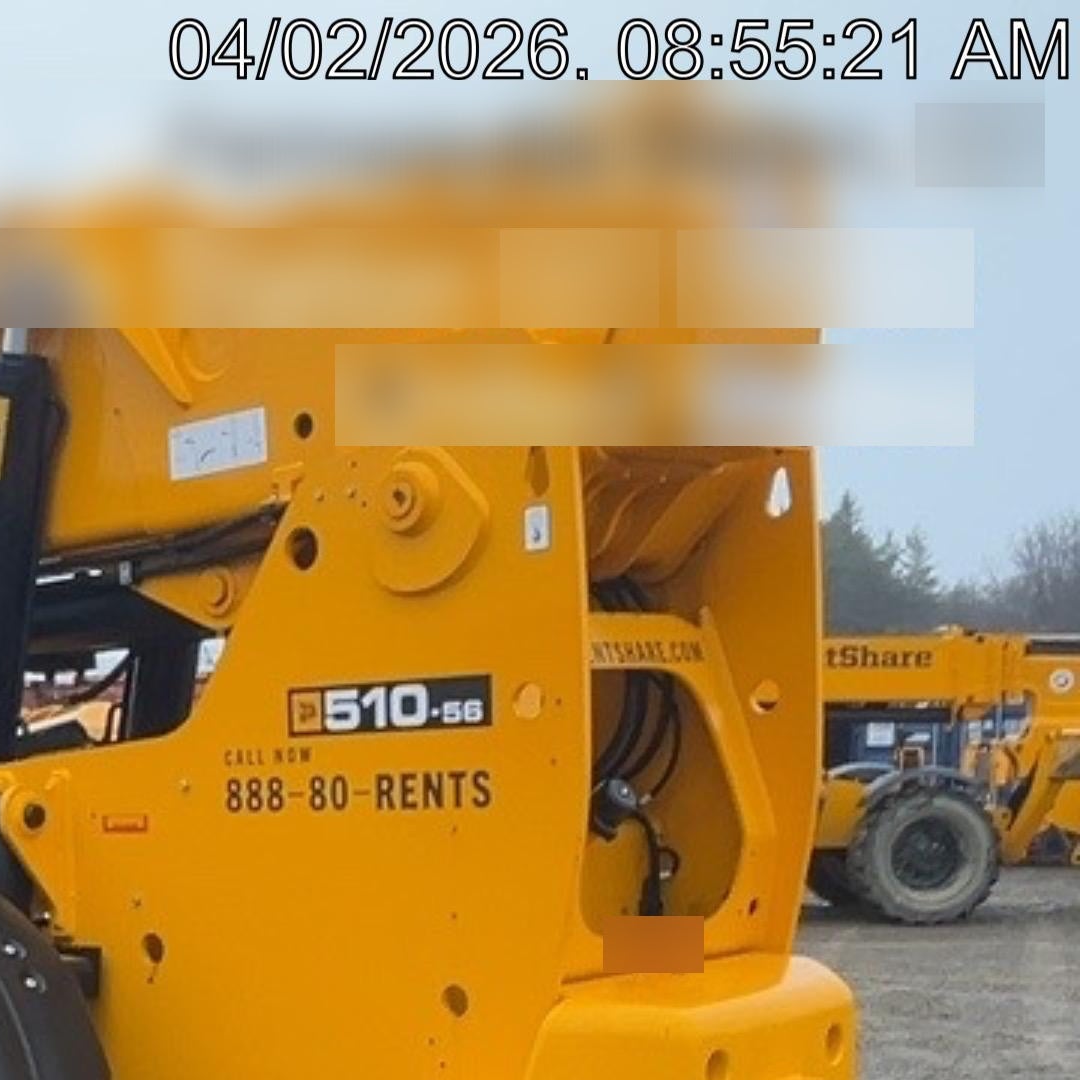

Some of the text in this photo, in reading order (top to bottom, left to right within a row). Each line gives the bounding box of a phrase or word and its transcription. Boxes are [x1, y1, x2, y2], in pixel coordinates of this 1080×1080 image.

[223, 747, 312, 767] CALL NOW
[226, 771, 493, 812] 888-80-RENTS
